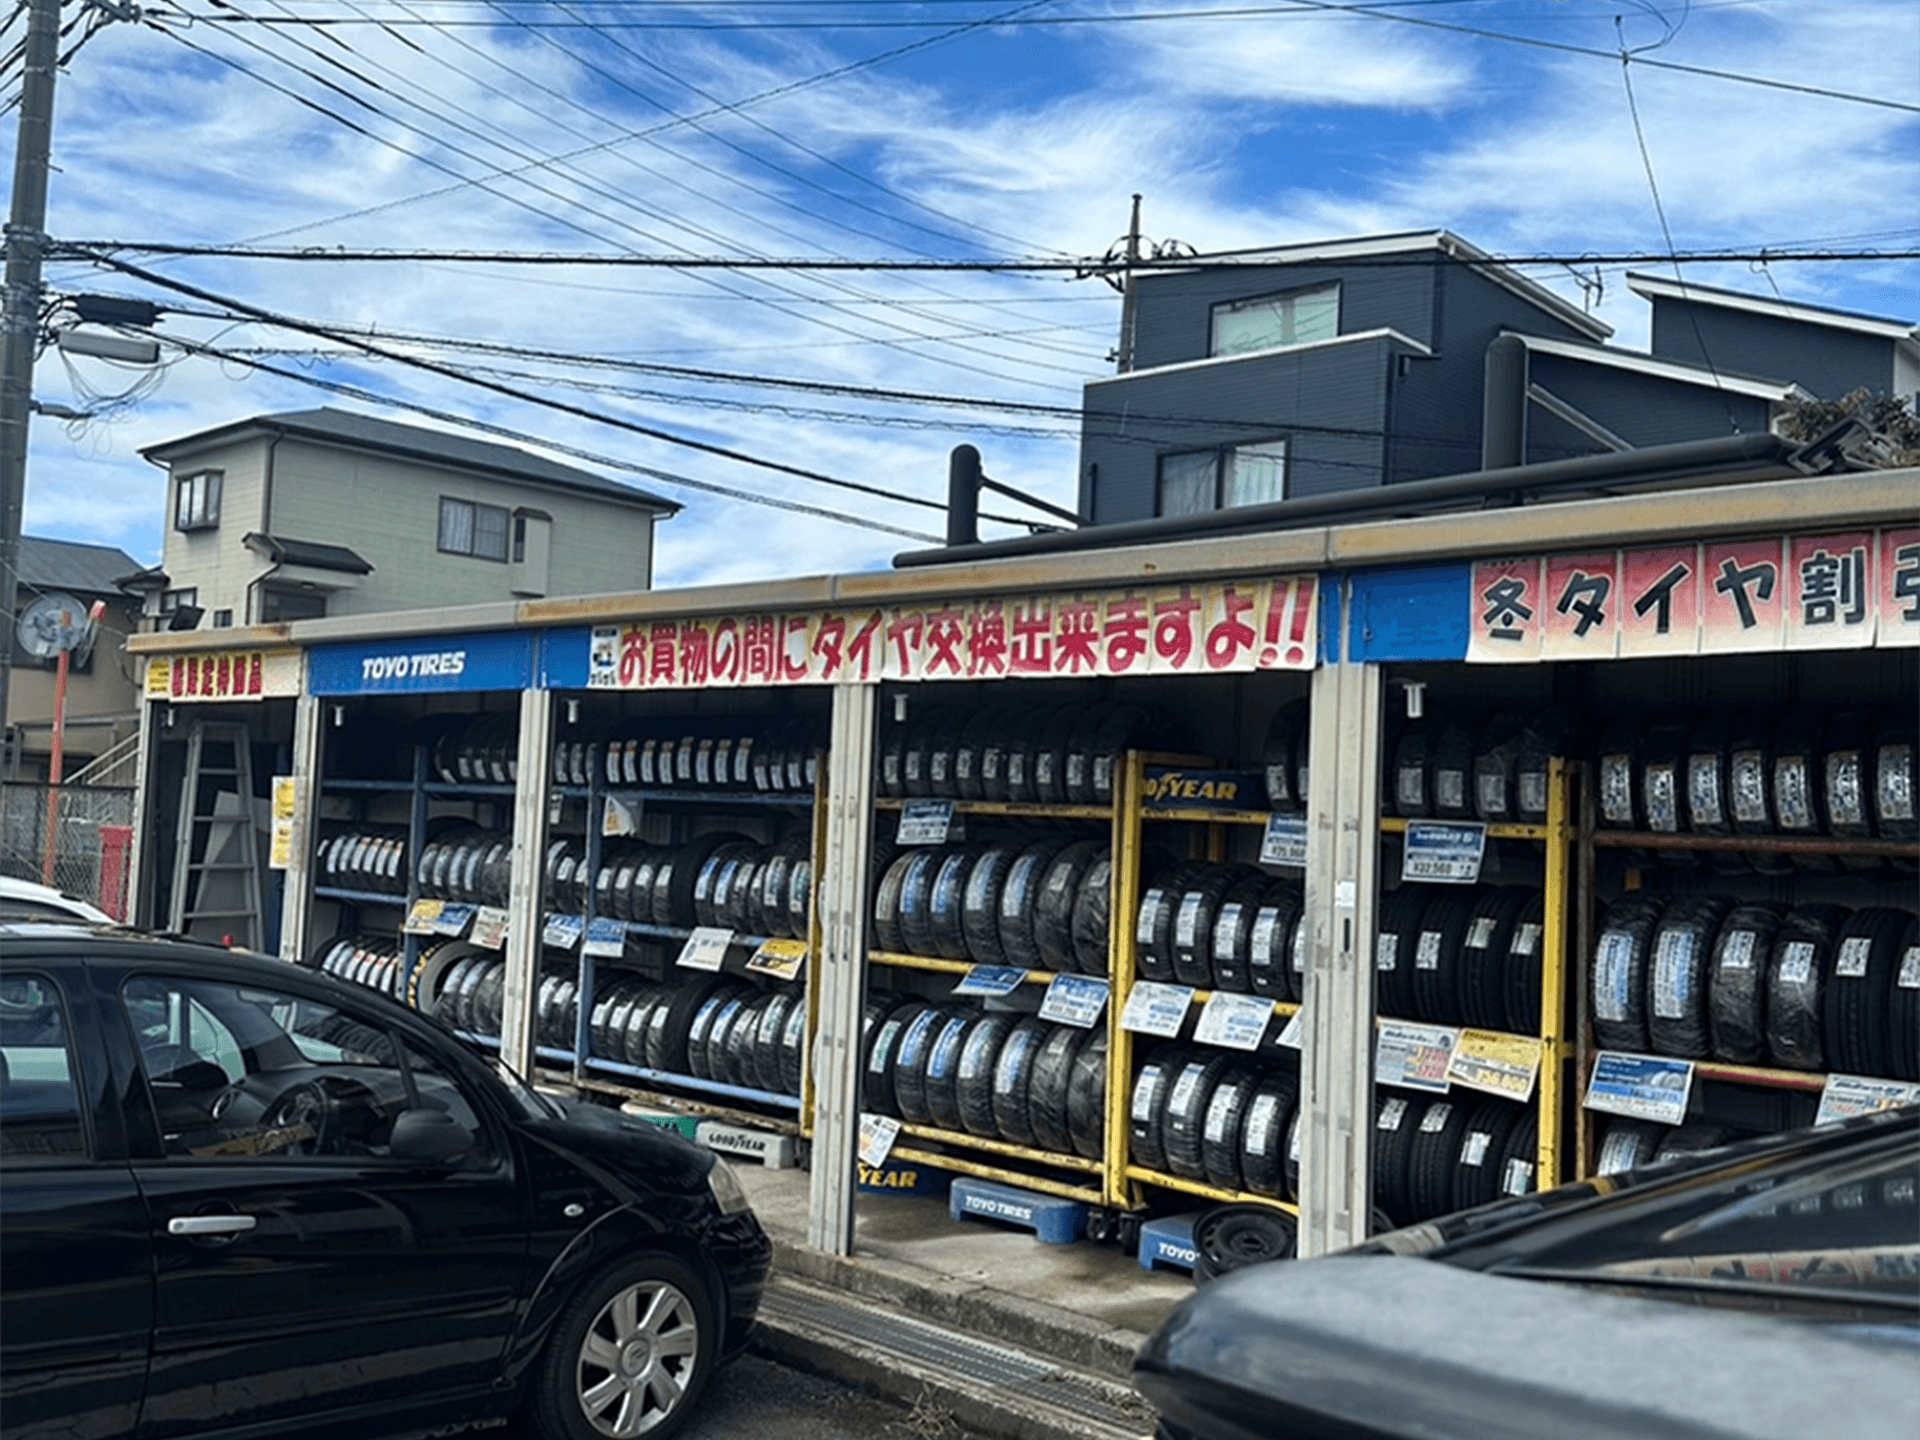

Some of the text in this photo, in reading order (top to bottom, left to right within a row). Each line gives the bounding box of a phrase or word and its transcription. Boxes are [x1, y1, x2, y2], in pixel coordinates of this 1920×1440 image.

[362, 652, 466, 679] TOYO TIRES
[965, 1195, 1033, 1221] TOYO TIRES
